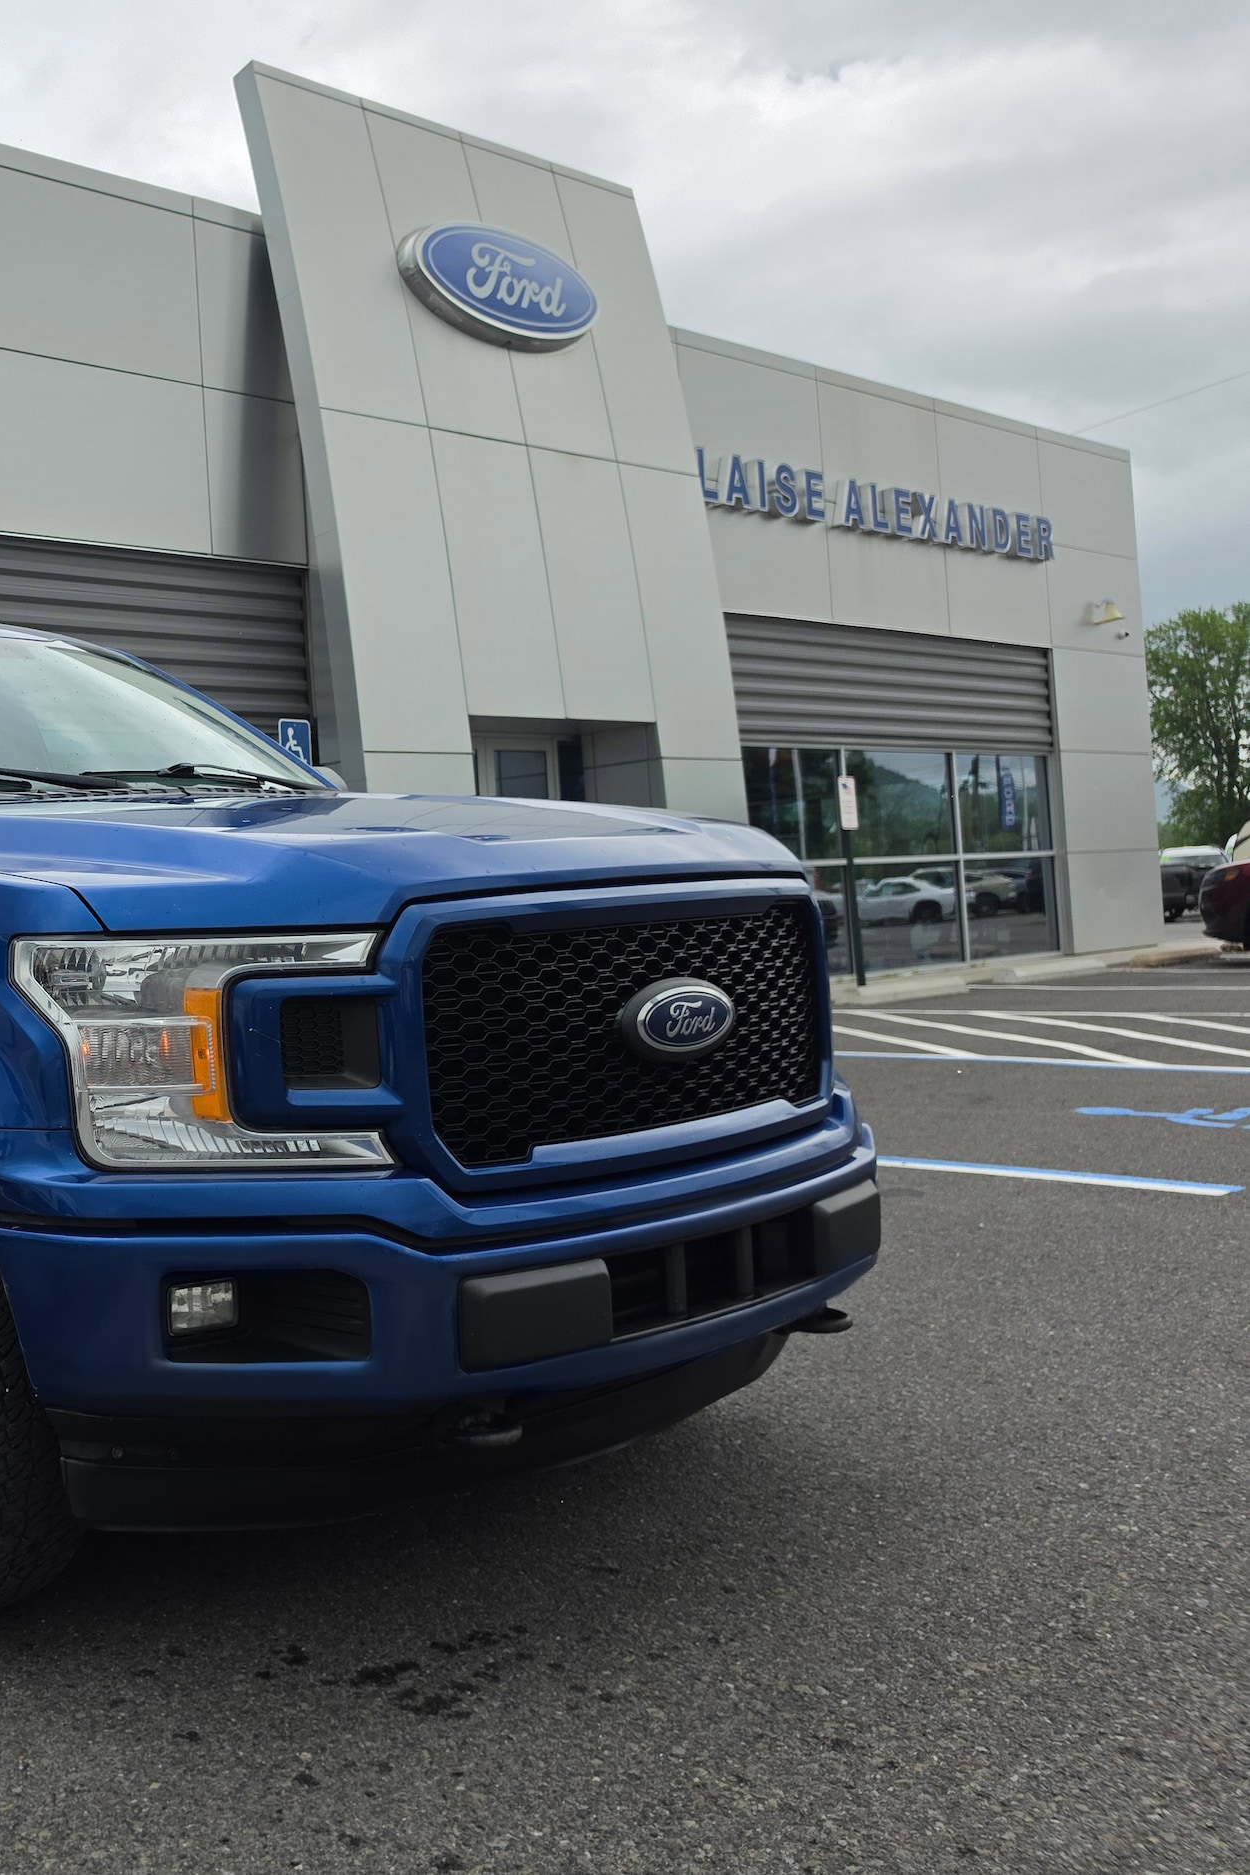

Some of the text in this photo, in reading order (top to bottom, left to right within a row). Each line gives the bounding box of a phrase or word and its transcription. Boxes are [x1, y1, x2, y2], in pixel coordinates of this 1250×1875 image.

[466, 242, 567, 318] Ford
[694, 446, 1055, 561] LAISE ALEXANDER
[666, 1000, 716, 1038] Ford
